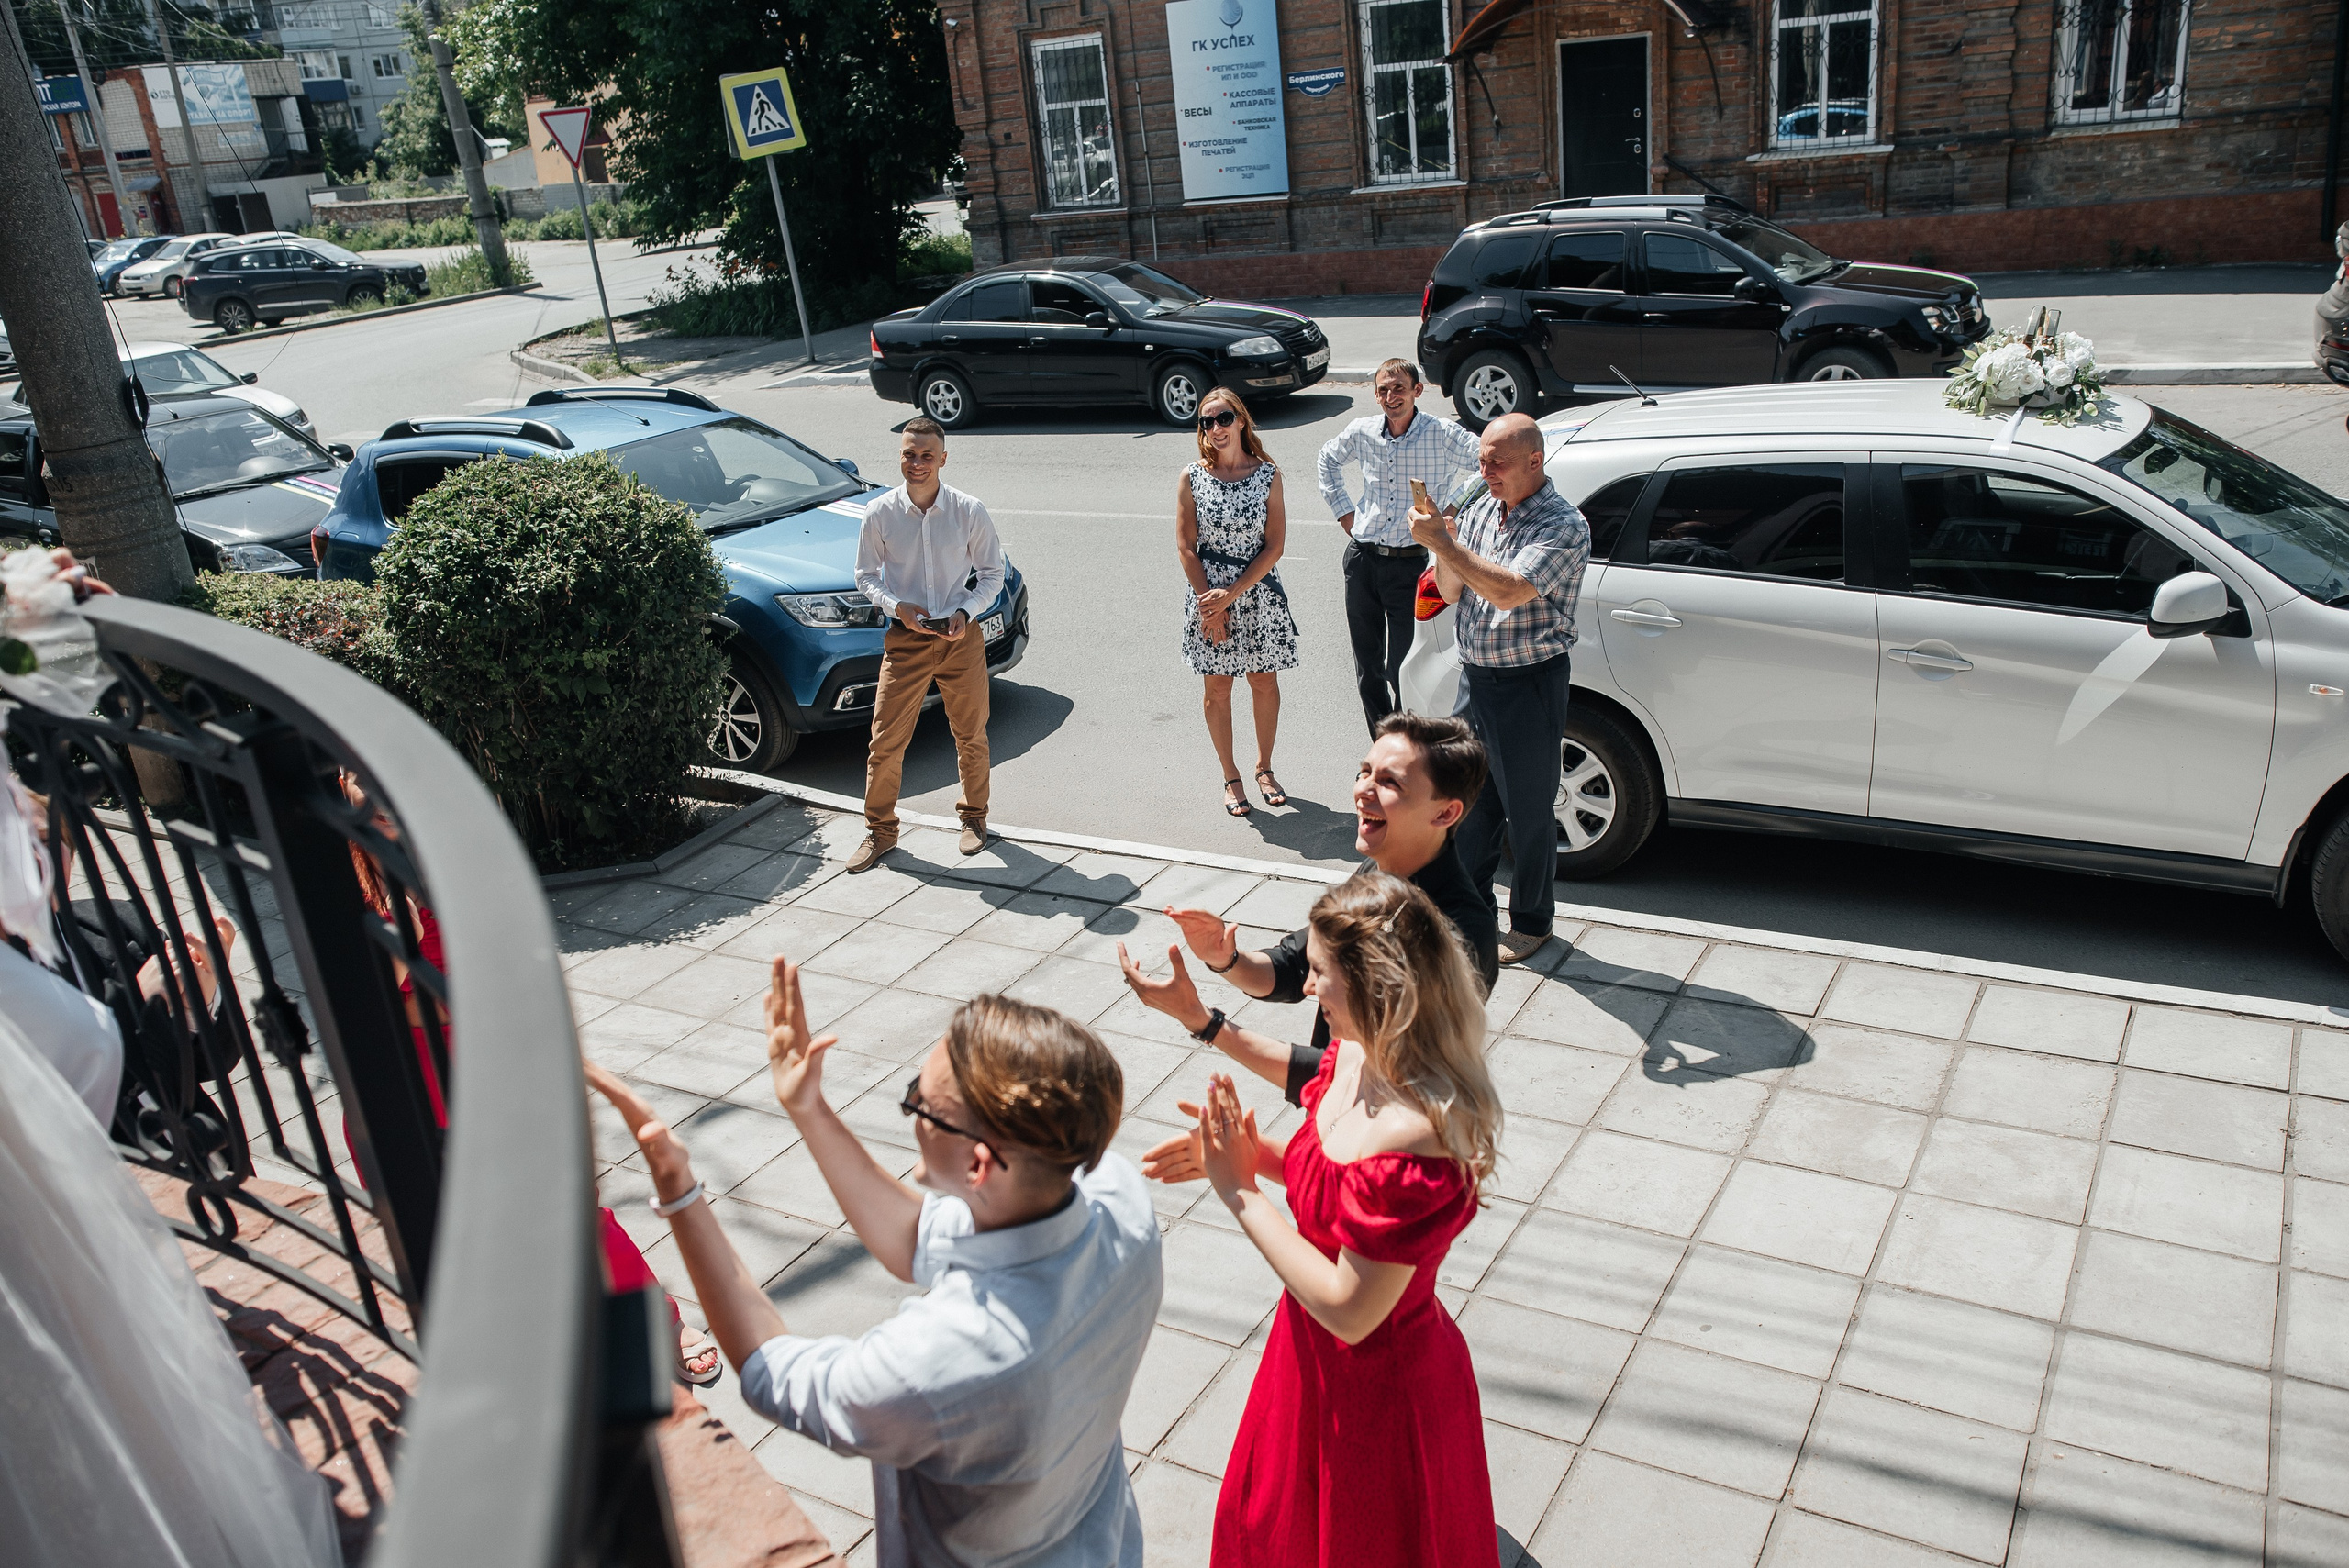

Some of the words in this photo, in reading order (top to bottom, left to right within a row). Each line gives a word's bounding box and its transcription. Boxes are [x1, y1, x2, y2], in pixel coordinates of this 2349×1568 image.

[1192, 39, 1208, 52] ГК
[1211, 34, 1255, 50] УСПЕХ
[1212, 61, 1266, 73] РЕГИСТРАЦИЯ
[1241, 71, 1258, 80] ООО
[1288, 72, 1344, 83] Берлинского
[1229, 87, 1275, 99] КАССОВЫЕ
[1230, 98, 1276, 109] АППАРАТЫ
[1184, 106, 1212, 118] ВЕСЫ
[1237, 117, 1276, 126] БАНКОВСКАЯ
[1188, 137, 1248, 149] ИЗГОТОВЛЕНИЕ
[1201, 146, 1236, 157] ПЕЧАТЕЙ
[1225, 163, 1271, 173] РЕГИСТРАЦИЯ
[985, 617, 1001, 634] 763
